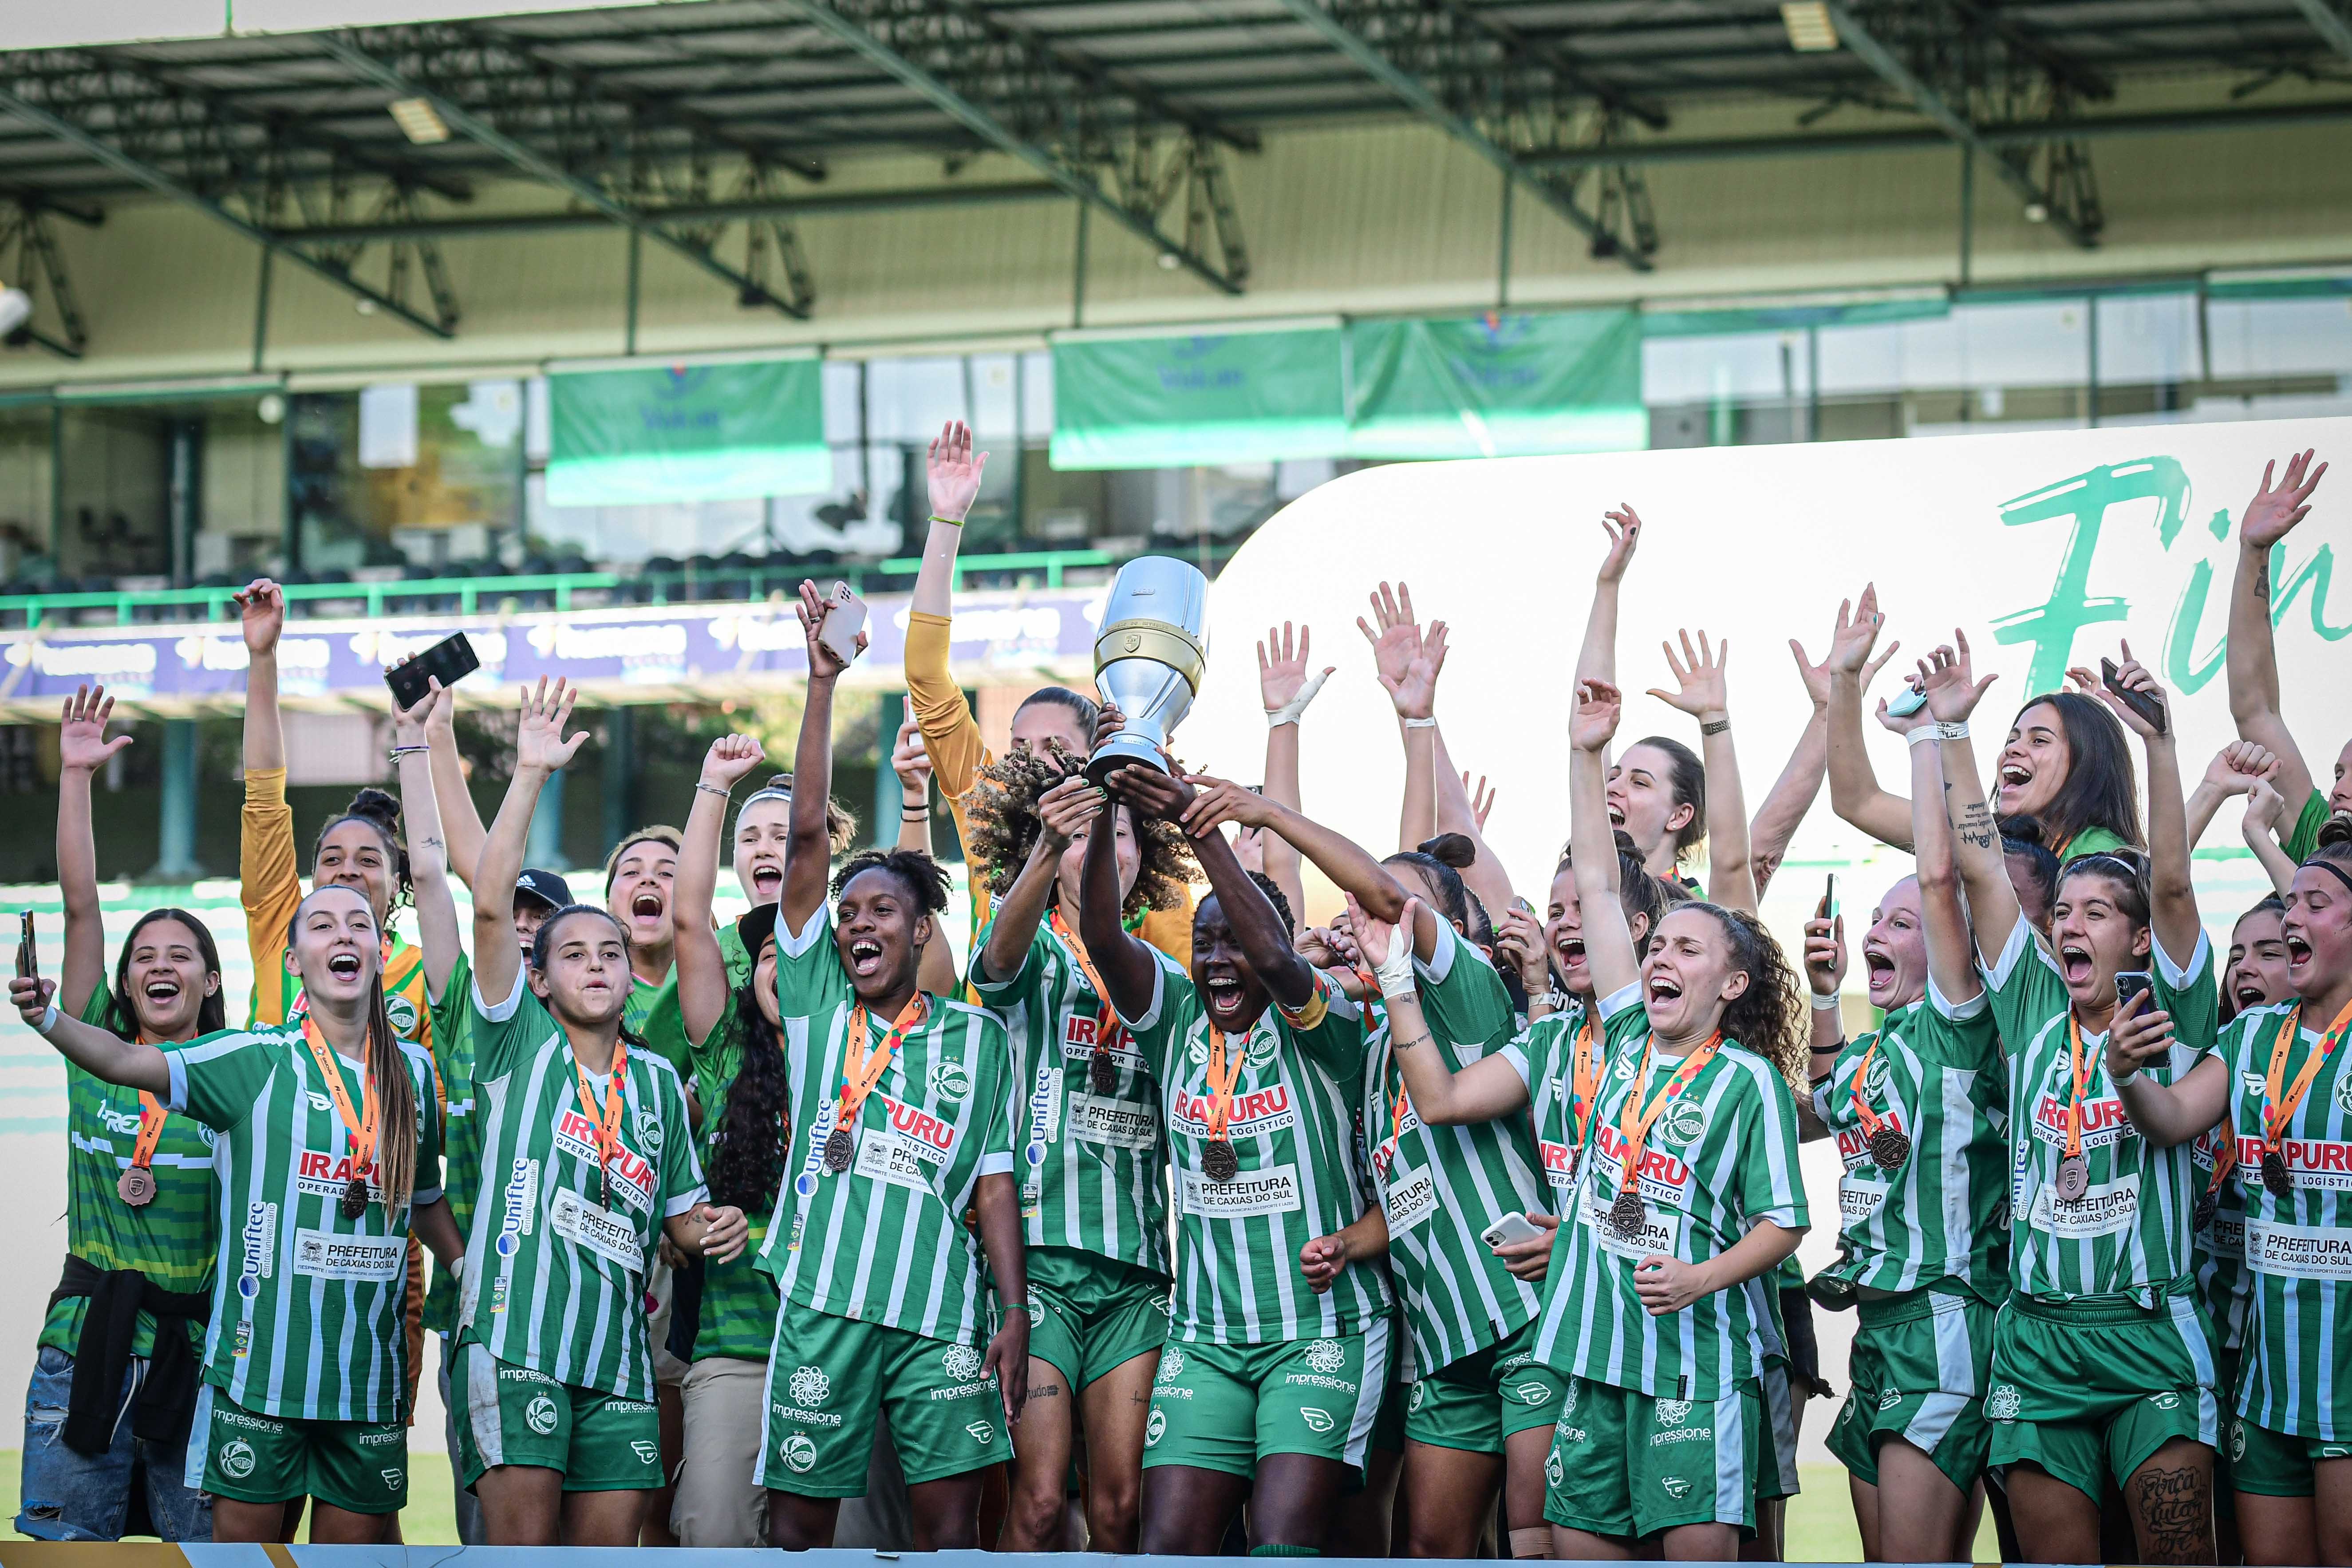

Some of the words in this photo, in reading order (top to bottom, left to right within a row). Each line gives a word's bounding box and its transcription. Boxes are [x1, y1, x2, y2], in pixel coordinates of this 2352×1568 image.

[946, 1080, 968, 1092] JUVENTUDE
[1050, 1069, 1062, 1117] universitário
[1032, 1069, 1050, 1141] Uniftec
[1176, 1085, 1287, 1123] IRAURU
[1088, 1106, 1155, 1128] PREFEITURA
[1229, 1115, 1294, 1136] LOGÍSTICO
[1676, 1120, 1703, 1134] JUVENTUDE
[805, 1100, 831, 1172] Uniftec
[1049, 1117, 1058, 1141] centro
[1087, 1120, 1098, 1129] DE
[1100, 1122, 1127, 1134] CAXIAS
[1139, 1128, 1152, 1137] SUL
[556, 1137, 600, 1164] OPERAD
[860, 1165, 888, 1177] FIESPORTE
[889, 1161, 903, 1172] DE
[298, 1181, 345, 1196] OPERAD
[505, 1159, 528, 1231] Uniftec
[526, 1161, 538, 1207] universitário
[1201, 1176, 1292, 1195] PREFEITURA
[1203, 1196, 1215, 1205] DE
[1217, 1195, 1253, 1205] CAXIAS
[1255, 1193, 1271, 1203] DO
[1273, 1189, 1293, 1199] SUL
[1409, 1199, 1424, 1209] DO
[2054, 1188, 2136, 1213] PREFEITURA
[524, 1208, 533, 1234] centro
[1859, 1207, 1871, 1216] DO
[2053, 1214, 2067, 1224] DE
[2070, 1213, 2102, 1224] CAXIAS
[2104, 1208, 2116, 1220] DO
[2119, 1202, 2137, 1214] SUL
[245, 1202, 264, 1274] Uniftec
[265, 1204, 276, 1252] universitário
[1603, 1227, 1628, 1243] CAXIAS
[1630, 1236, 1646, 1247] DO
[1649, 1240, 1669, 1251] SUL
[328, 1244, 398, 1259] PREFEITURA
[579, 1222, 589, 1234] DE
[590, 1228, 618, 1248] CAXIAS
[619, 1243, 631, 1253] DO
[632, 1248, 643, 1260] SUL
[2266, 1234, 2352, 1254] PREFEITURA
[326, 1258, 339, 1267] DE
[340, 1259, 371, 1269] CAXIAS
[373, 1260, 385, 1269] DO
[385, 1260, 395, 1268] SUL
[2265, 1250, 2278, 1260] DE
[2281, 1252, 2309, 1264] CAXIAS
[2311, 1255, 2327, 1264] DO
[2330, 1256, 2352, 1266] SUL
[930, 1378, 997, 1401] impressione
[1285, 1372, 1357, 1393] impressione
[213, 1405, 284, 1432] impressione
[772, 1400, 841, 1425] impressione
